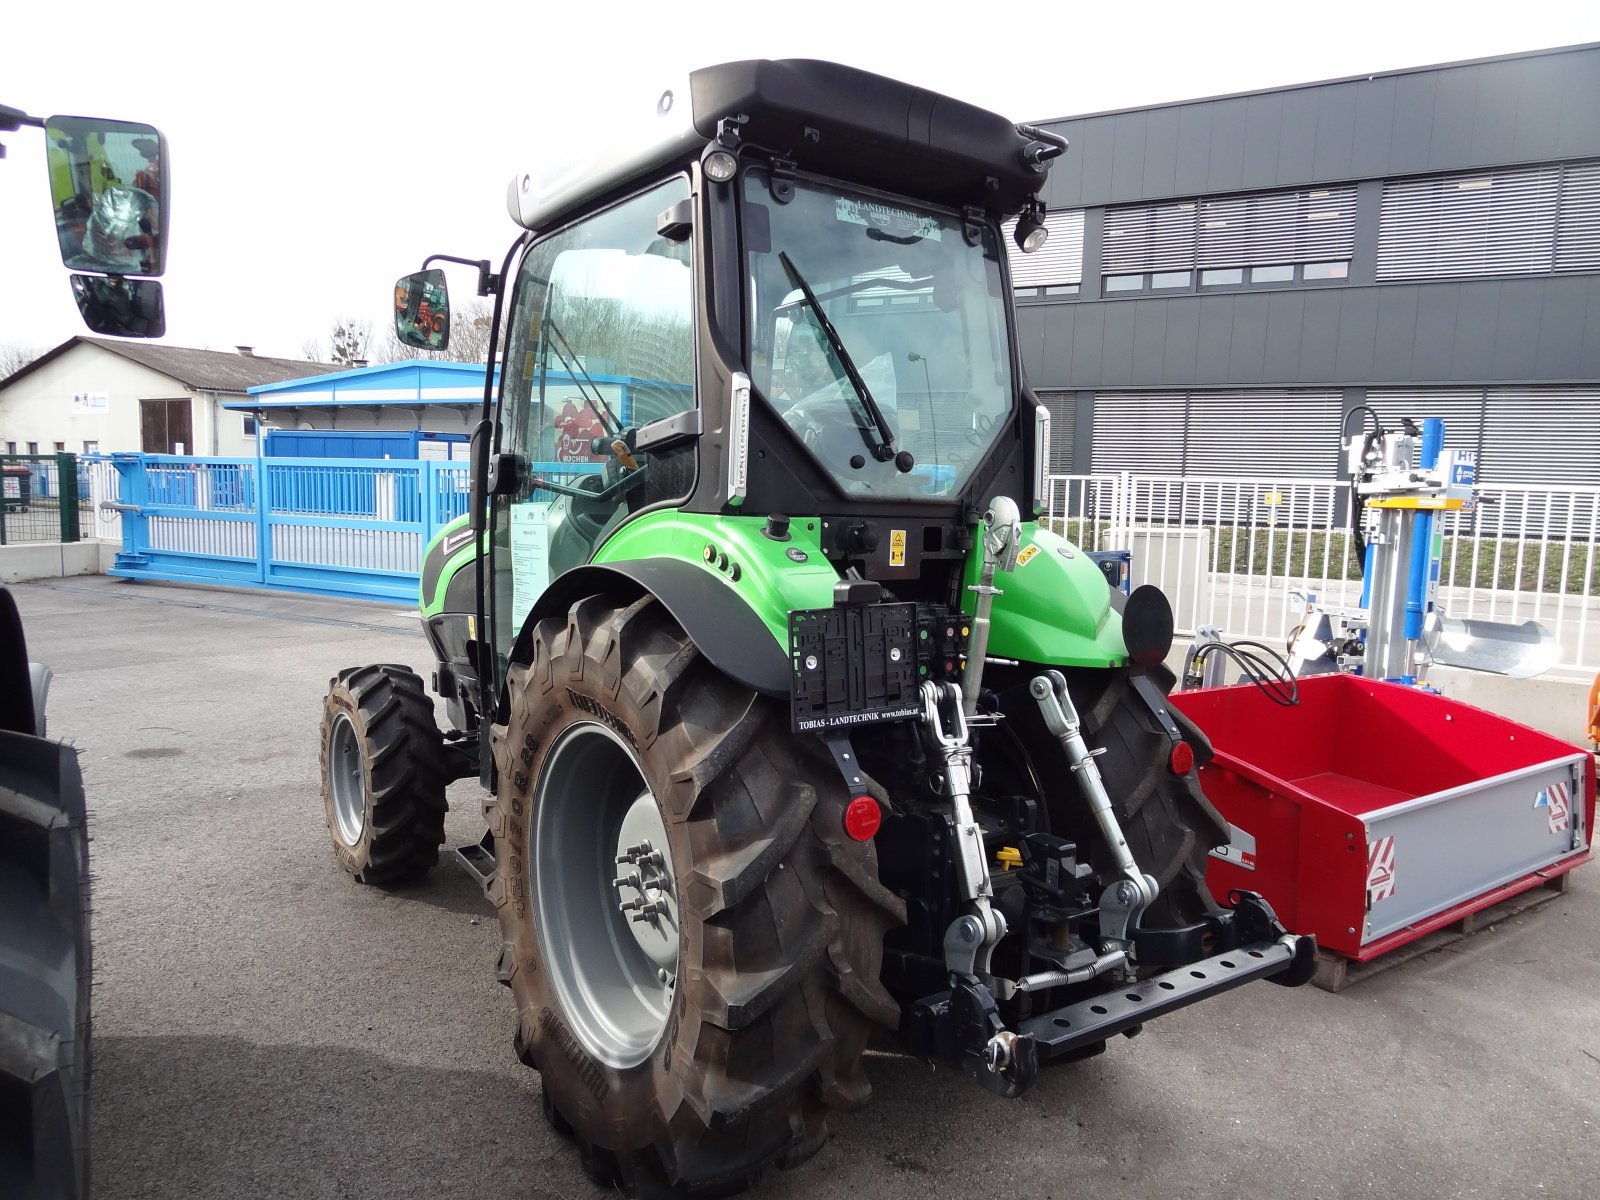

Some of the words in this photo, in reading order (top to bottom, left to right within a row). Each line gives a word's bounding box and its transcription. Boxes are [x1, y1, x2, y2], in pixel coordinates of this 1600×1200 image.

[799, 719, 826, 730] TOBIAS
[830, 711, 880, 726] LANDTECHNIK
[881, 707, 919, 719] www.tobias.at
[515, 770, 528, 794] R
